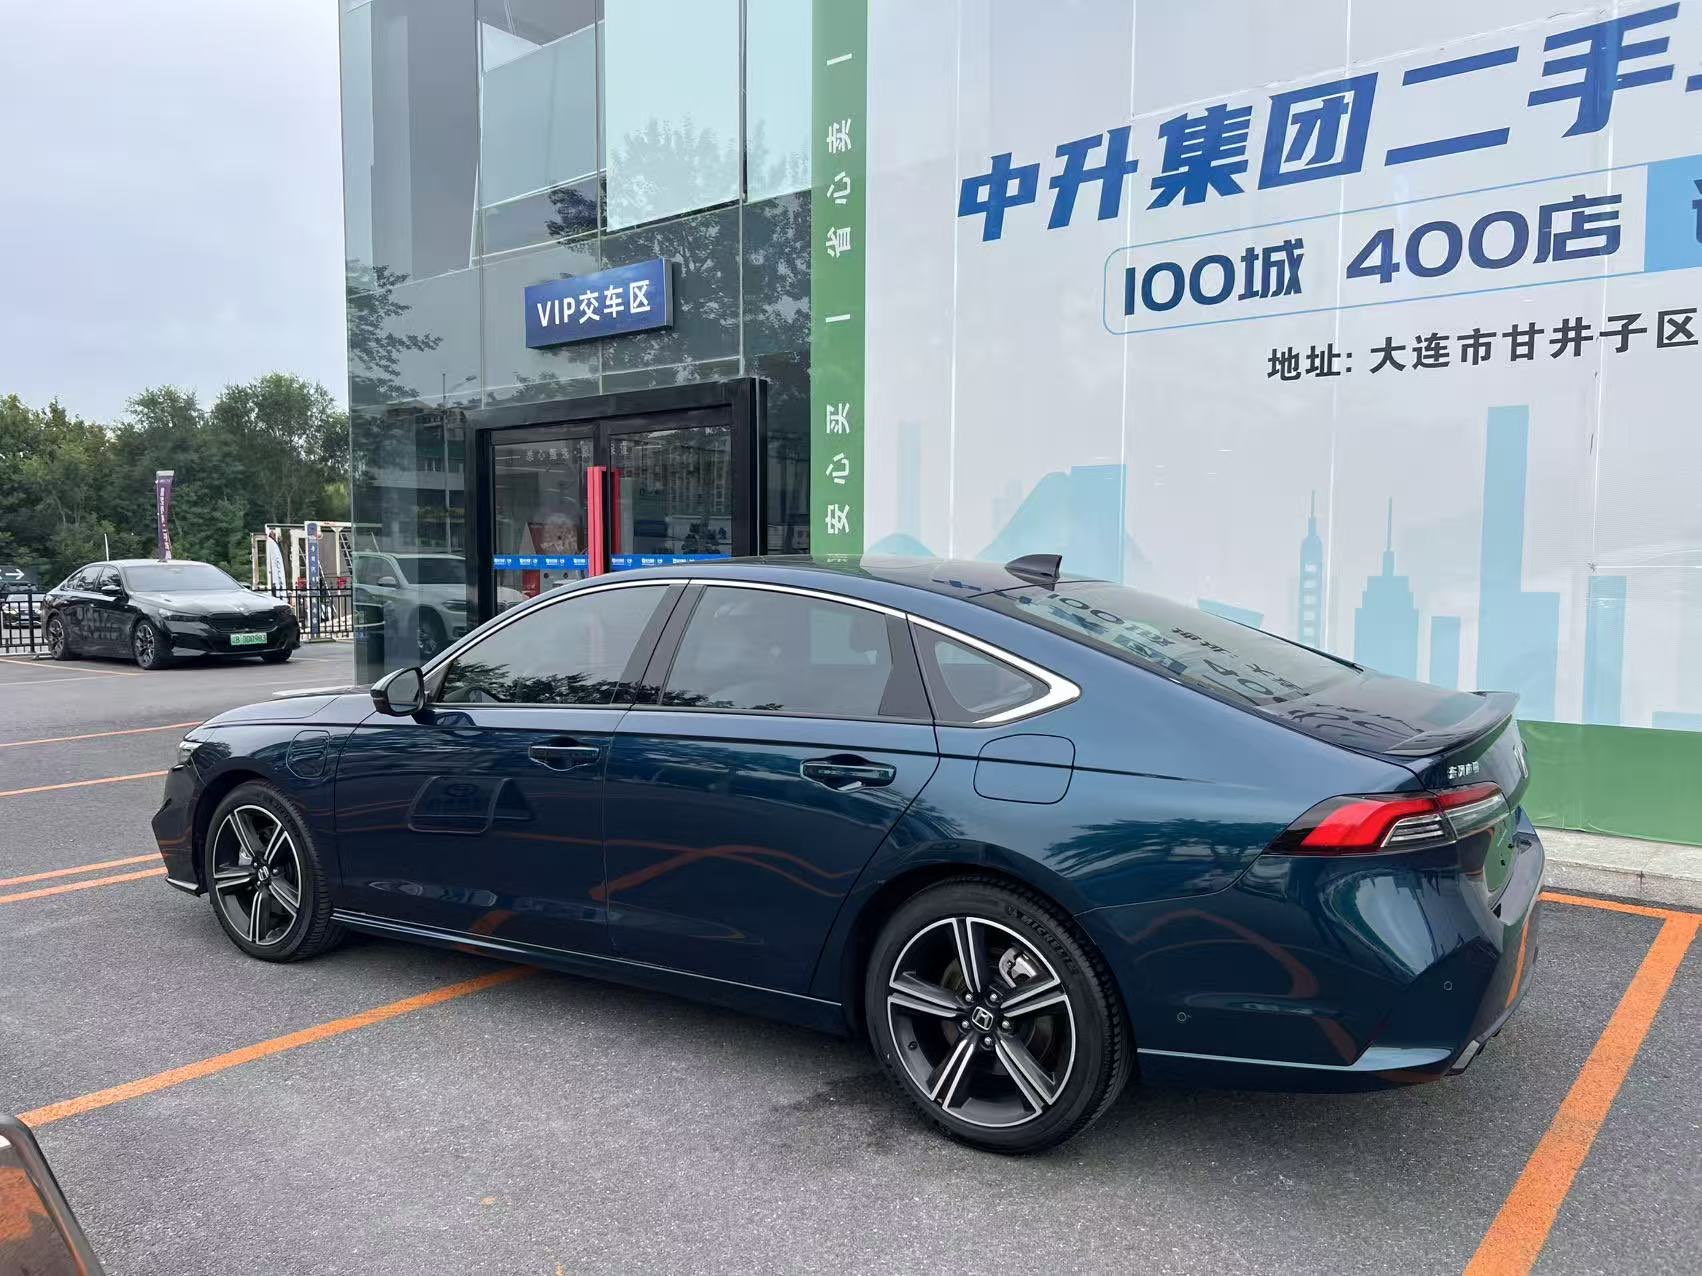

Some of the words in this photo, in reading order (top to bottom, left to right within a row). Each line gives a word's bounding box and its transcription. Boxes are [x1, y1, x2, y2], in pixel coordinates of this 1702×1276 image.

[957, 2, 1702, 242] 中升集团二手
[537, 279, 651, 327] VIP交车区
[1123, 237, 1304, 316] 100城
[1346, 193, 1622, 285] 400店
